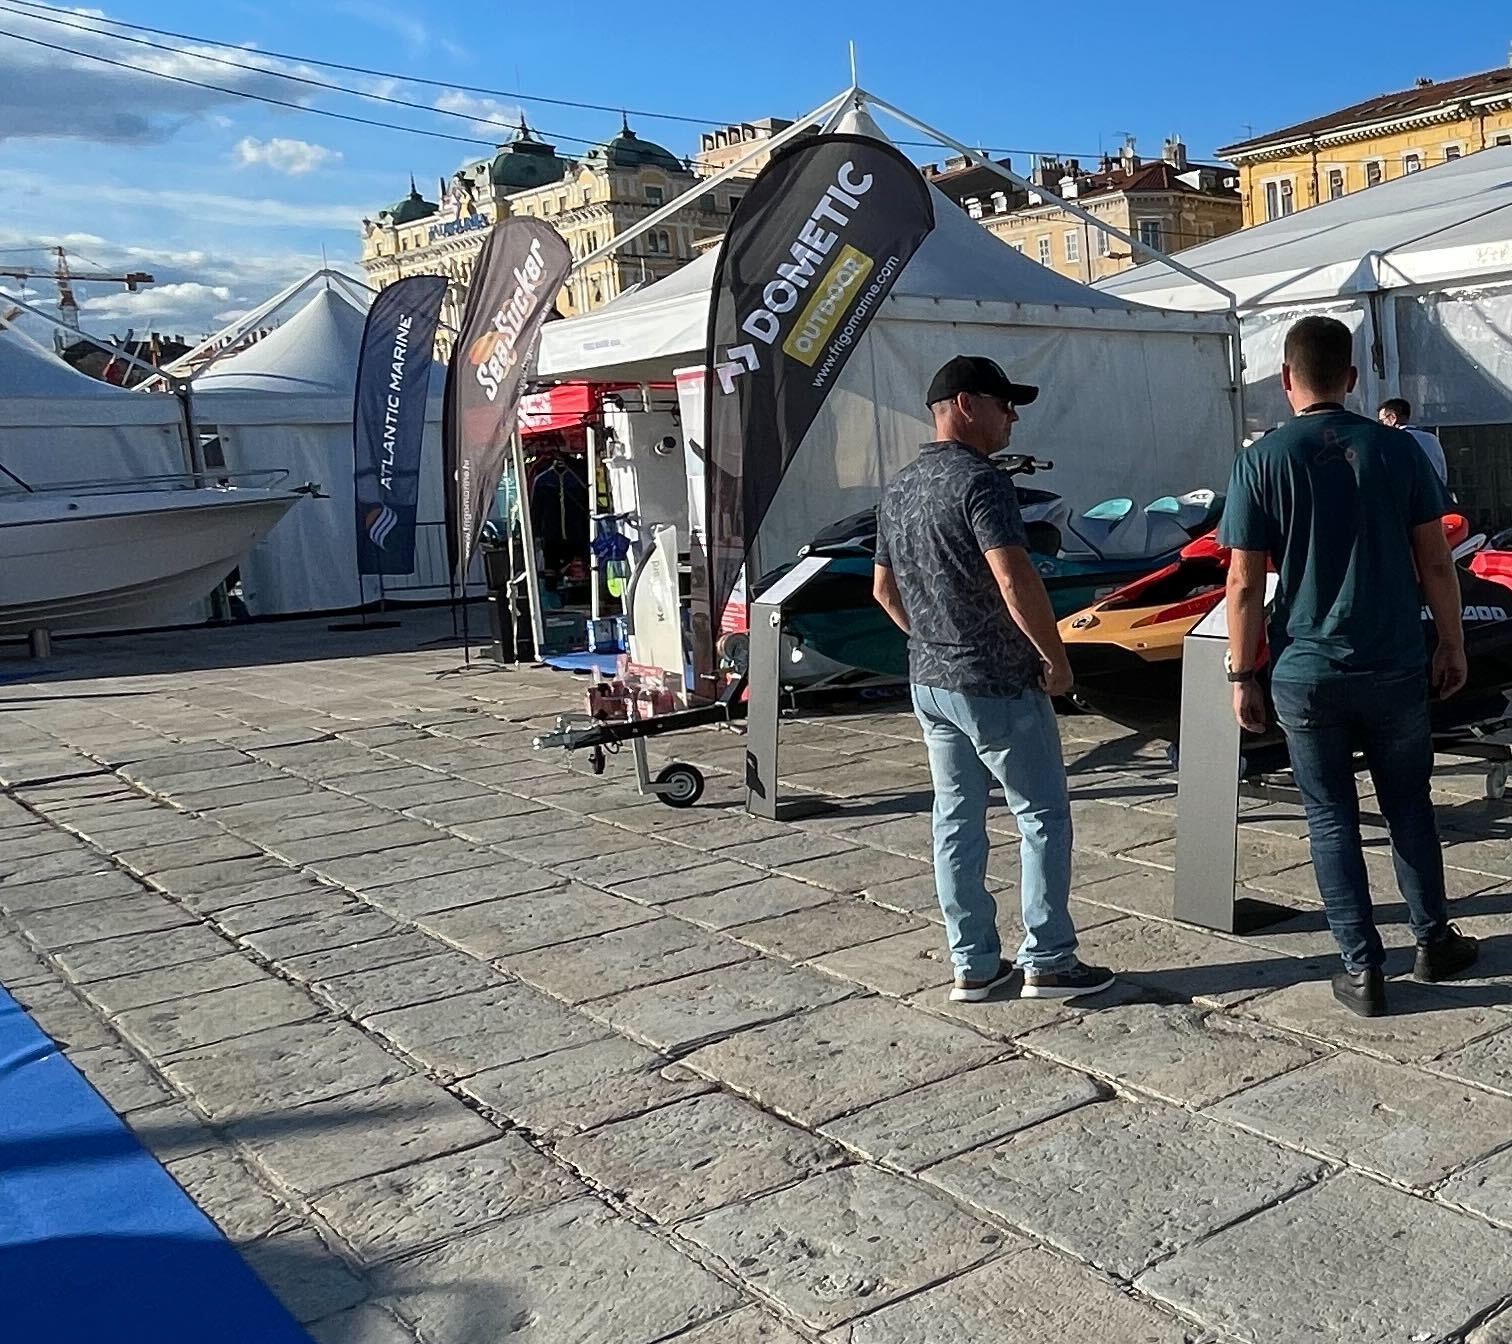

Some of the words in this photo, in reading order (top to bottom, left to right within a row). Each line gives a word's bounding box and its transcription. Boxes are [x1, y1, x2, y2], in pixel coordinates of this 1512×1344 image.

[741, 160, 874, 345] DOMETIC
[389, 313, 413, 392] MARINE
[794, 257, 864, 354] OUTDOOR
[811, 255, 900, 389] www.frigomarine.com
[380, 396, 400, 491] ATLANTIC
